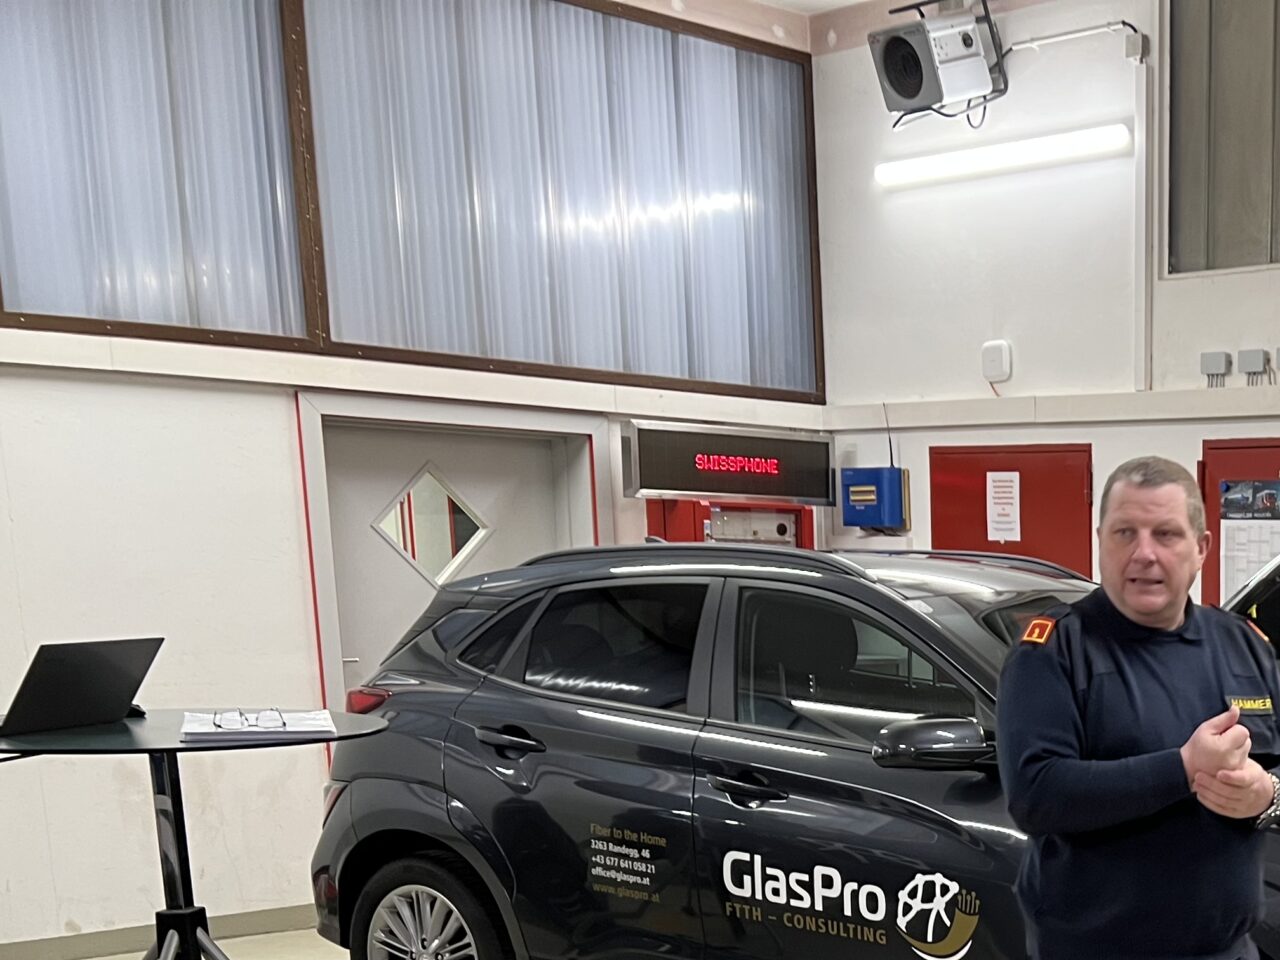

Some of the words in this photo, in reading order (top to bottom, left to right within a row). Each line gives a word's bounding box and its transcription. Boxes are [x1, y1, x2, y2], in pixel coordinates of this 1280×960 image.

[695, 453, 779, 474] SWISSPHONE
[1231, 698, 1272, 709] HAMMER
[590, 823, 611, 837] Fiber
[613, 828, 622, 839] to
[624, 829, 638, 841] the
[640, 832, 667, 847] Home
[590, 839, 607, 851] 3263
[608, 842, 640, 858] Randegg,
[591, 854, 604, 864] +43
[605, 856, 619, 867] 677
[620, 859, 633, 869] 641
[633, 862, 647, 872] 058
[647, 864, 656, 874] 21
[591, 866, 650, 886] office@glaspro.at
[722, 850, 887, 922] GlasPro
[725, 901, 762, 922] FTTH
[783, 912, 887, 945] CONSULTING
